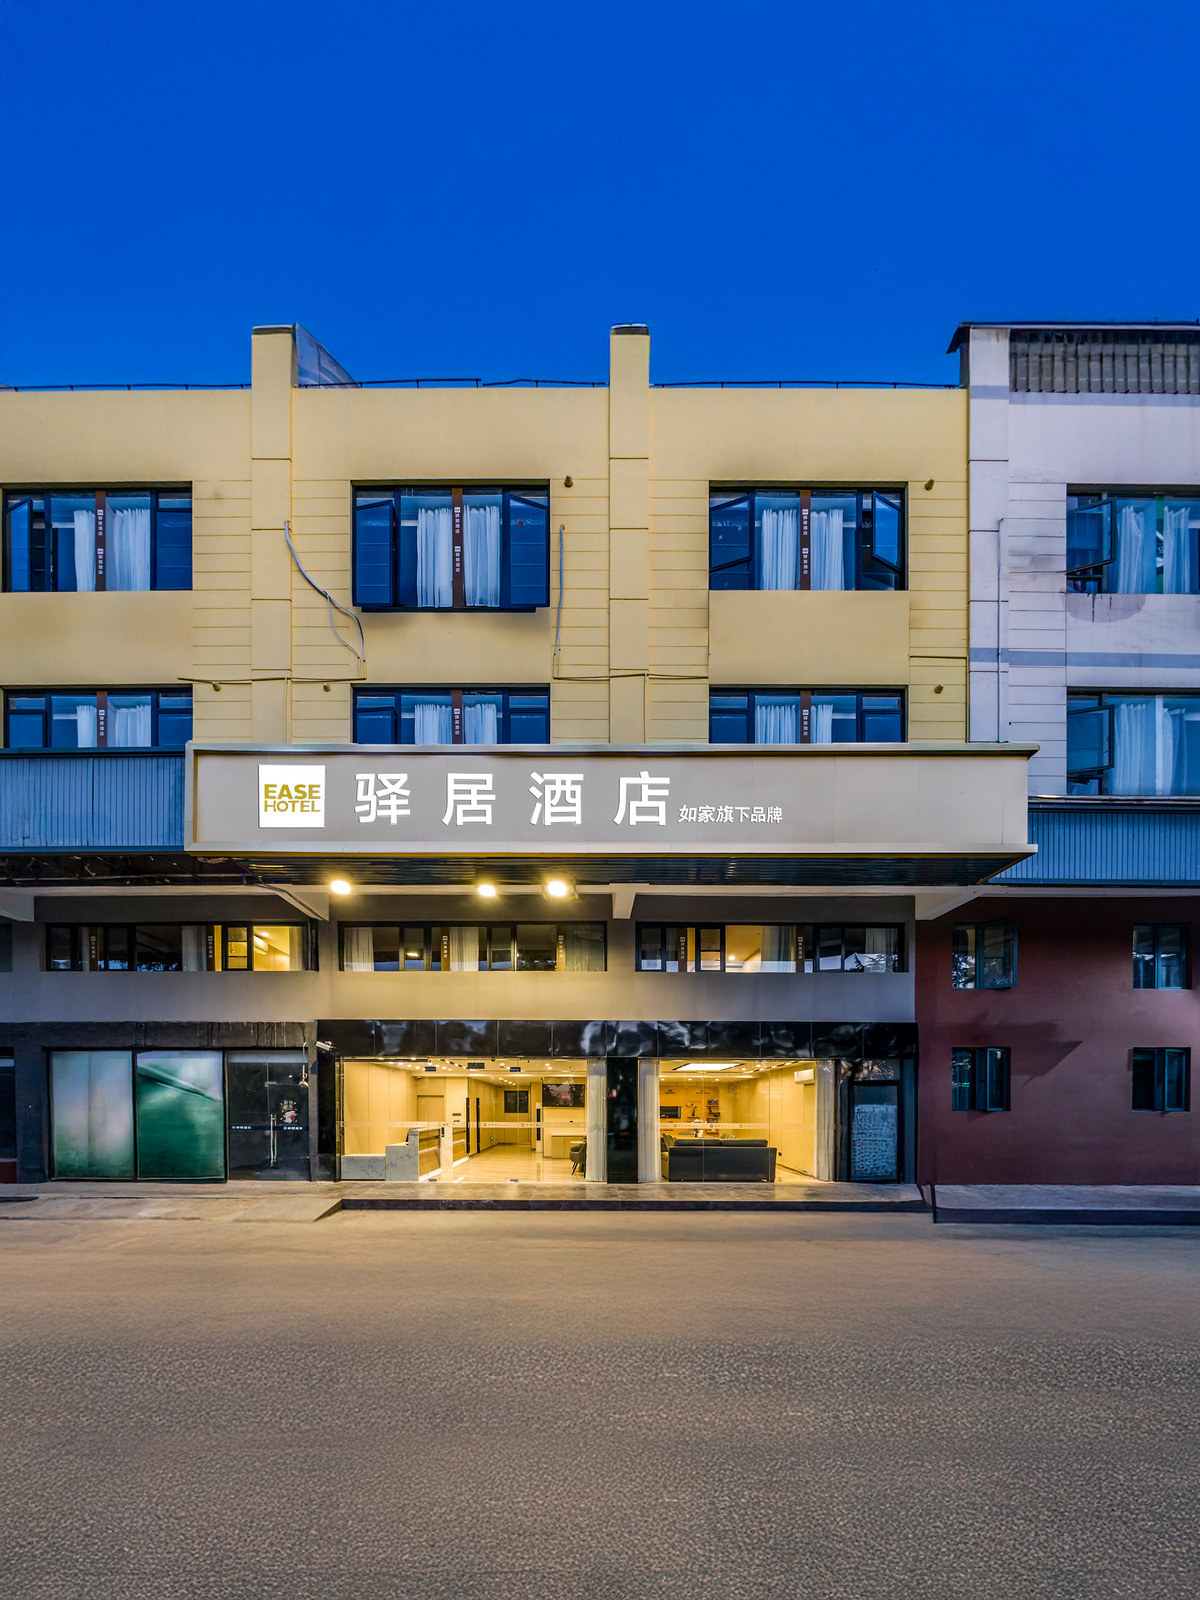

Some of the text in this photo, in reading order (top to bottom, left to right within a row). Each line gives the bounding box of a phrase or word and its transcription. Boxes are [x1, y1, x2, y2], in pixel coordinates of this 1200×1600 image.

[264, 784, 321, 800] EASE
[354, 771, 671, 826] 驿居酒店
[264, 800, 321, 813] HOTEL
[678, 805, 783, 823] 如家旗下品牌
